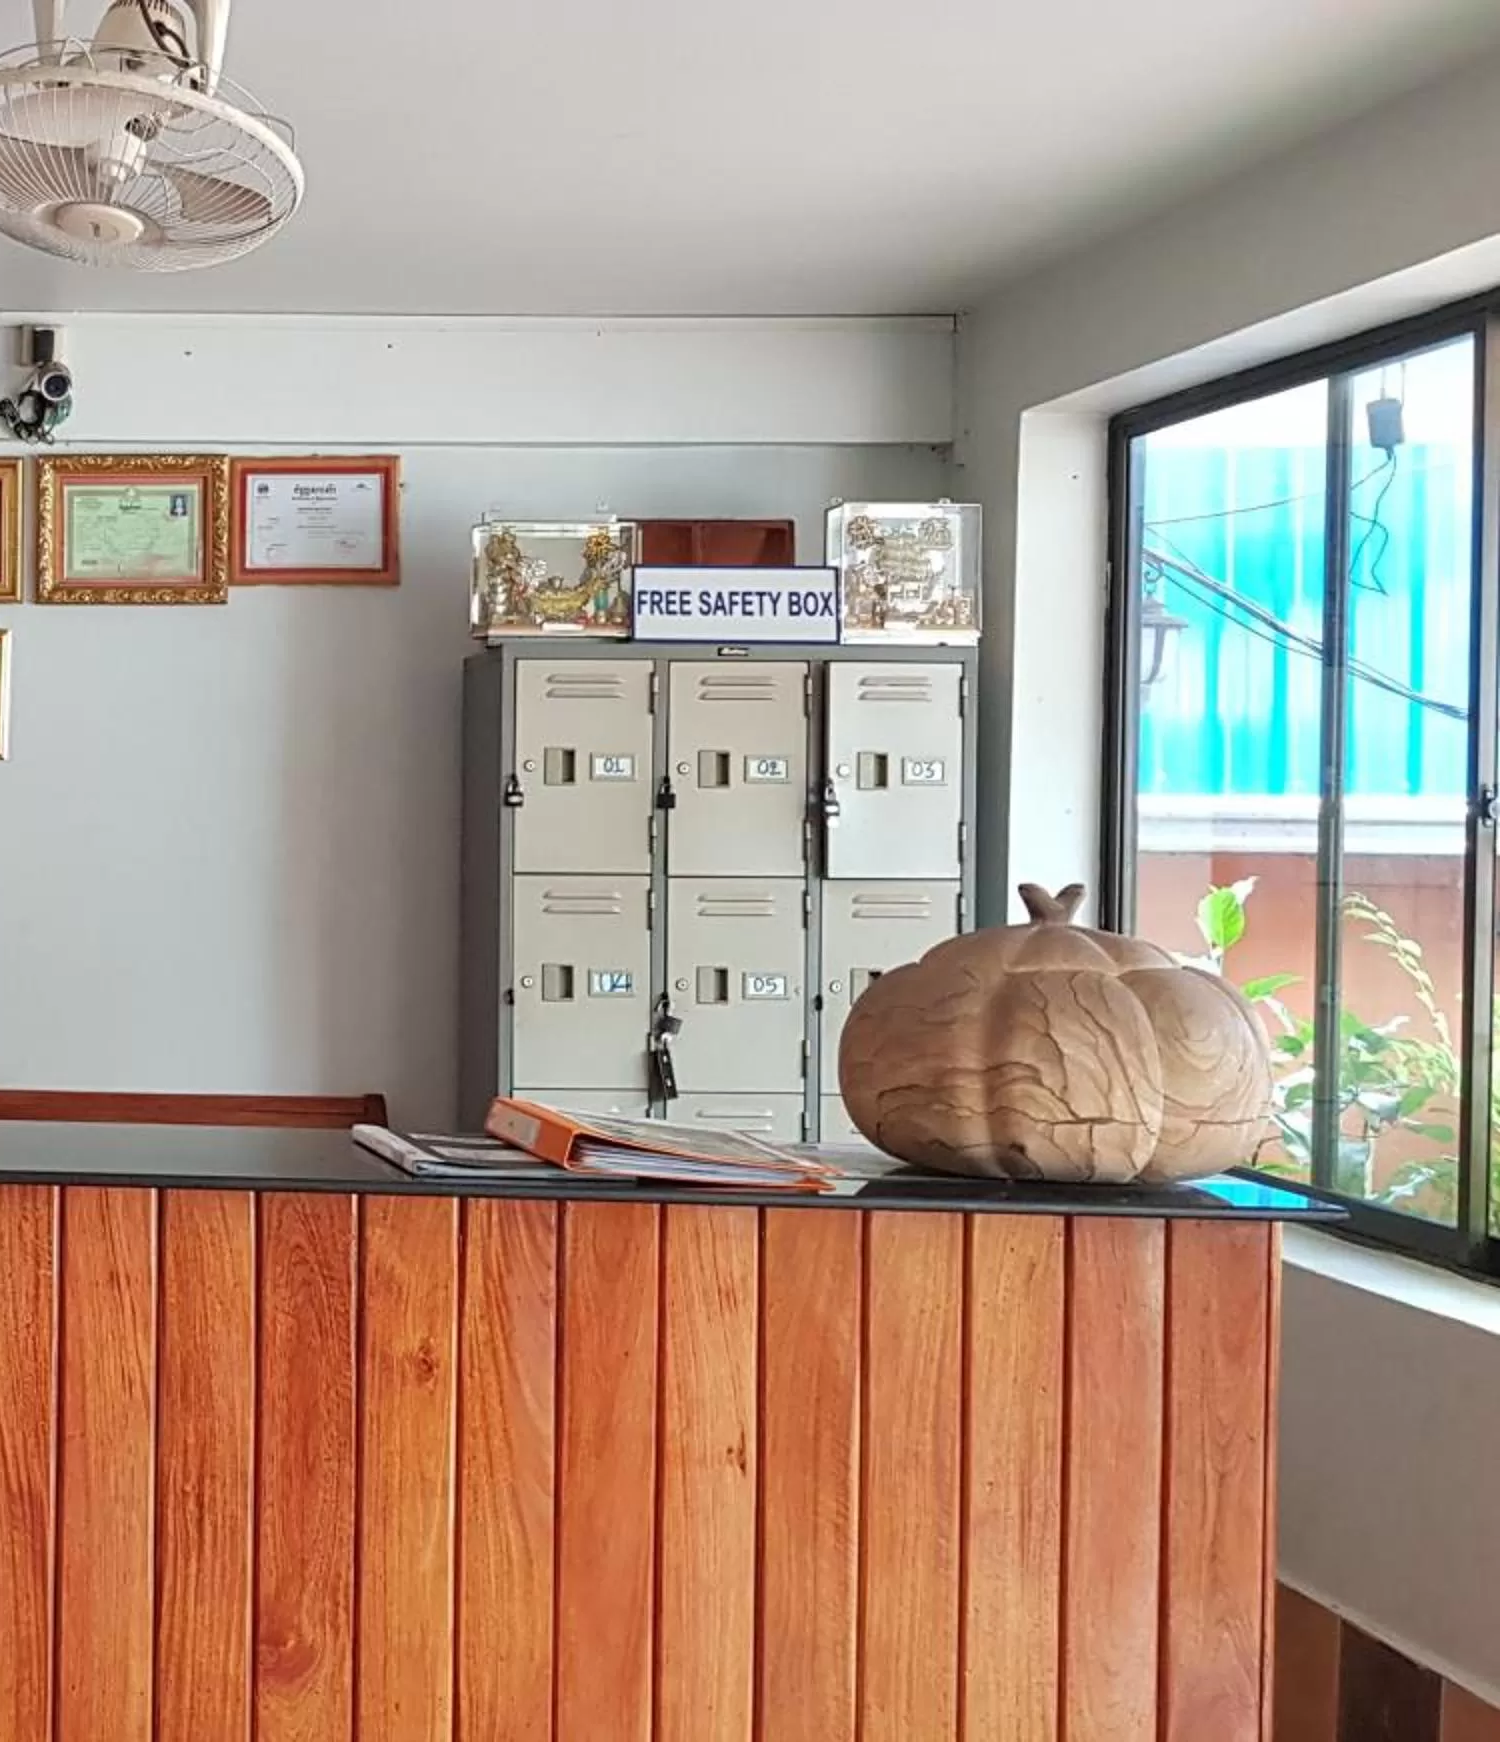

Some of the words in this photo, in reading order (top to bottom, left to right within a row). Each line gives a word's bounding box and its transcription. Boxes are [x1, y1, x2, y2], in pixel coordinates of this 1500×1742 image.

[636, 590, 692, 616] FREE
[699, 591, 781, 616] SAFETY
[788, 591, 834, 617] BOX
[603, 757, 625, 774] 01
[757, 761, 782, 777] 02
[911, 761, 935, 778] 03
[753, 977, 778, 993] 05
